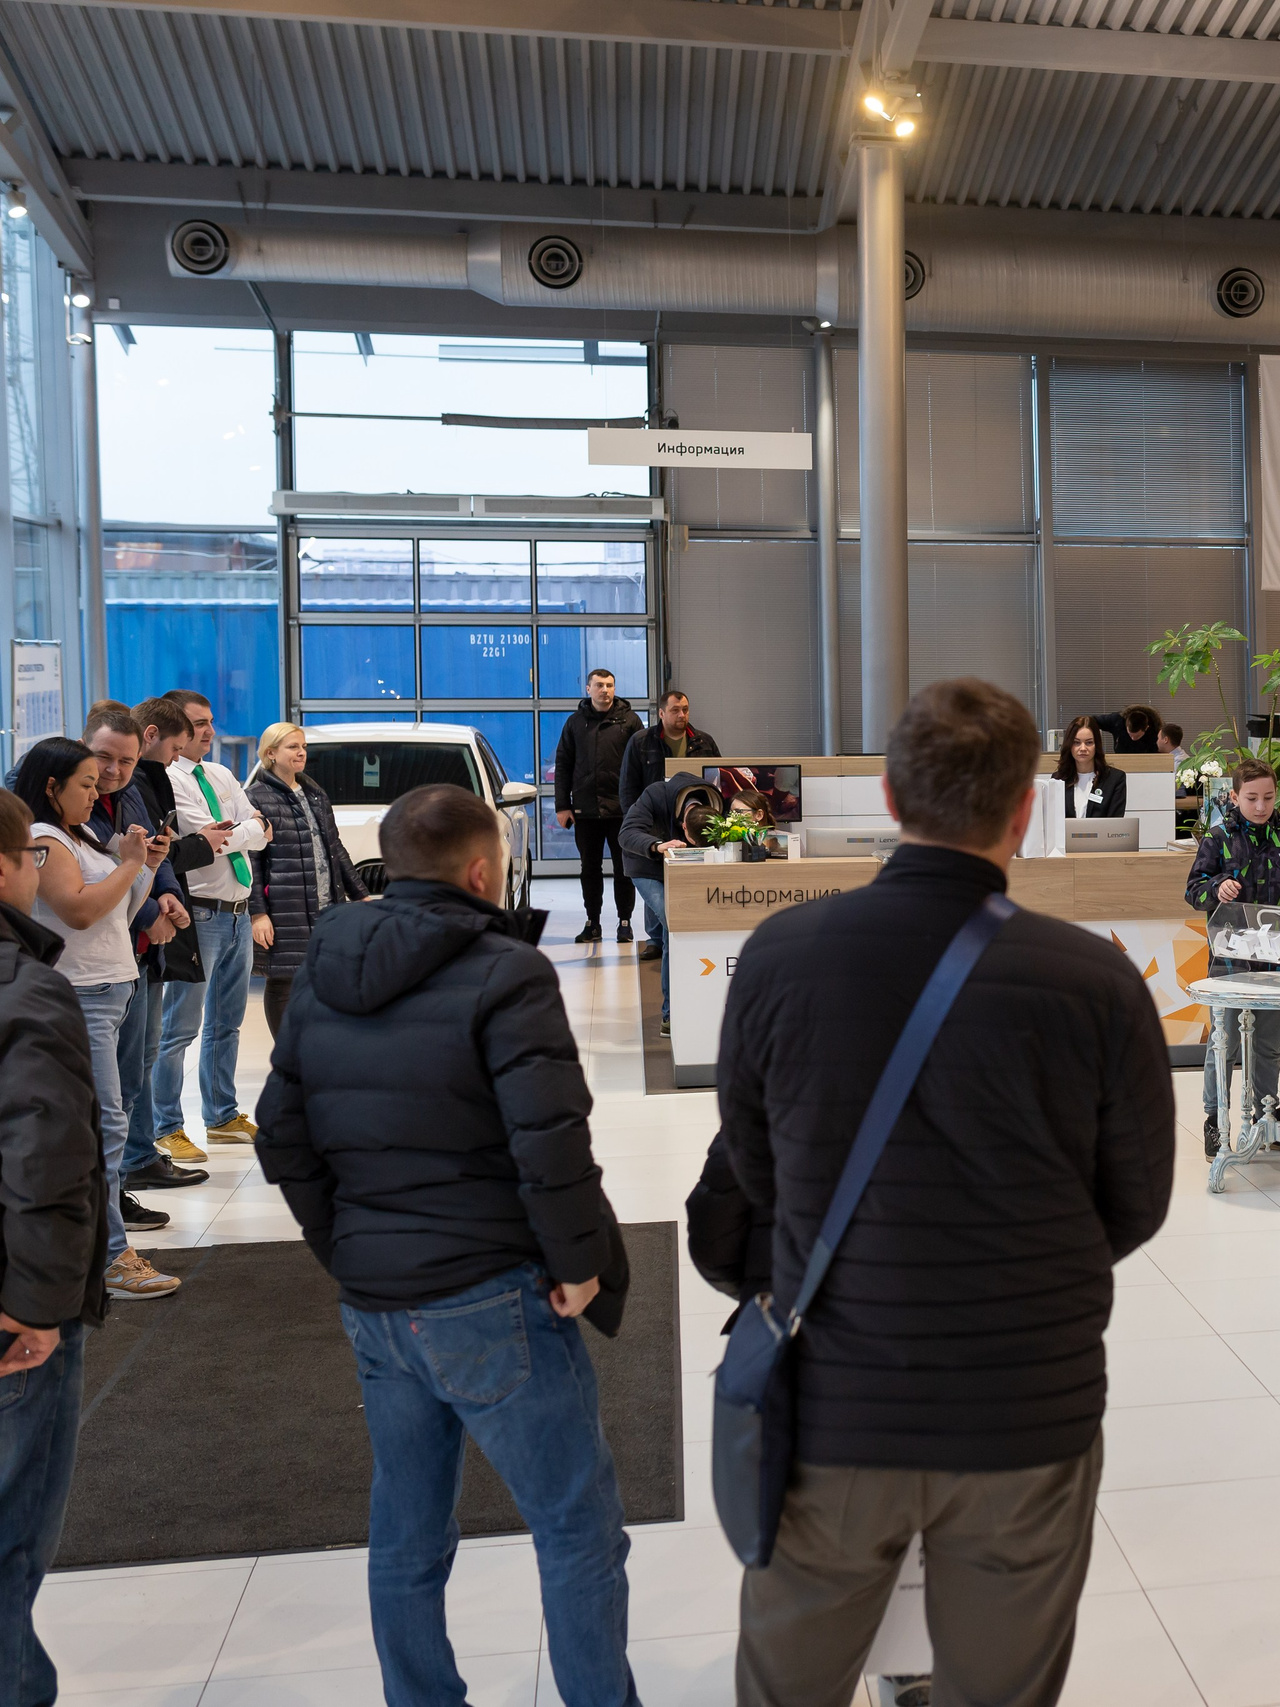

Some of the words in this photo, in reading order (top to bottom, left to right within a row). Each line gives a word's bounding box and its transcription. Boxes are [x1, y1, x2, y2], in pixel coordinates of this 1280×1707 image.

[657, 442, 745, 457] Информация
[470, 633, 494, 645] BZTU
[500, 633, 532, 645] 21300
